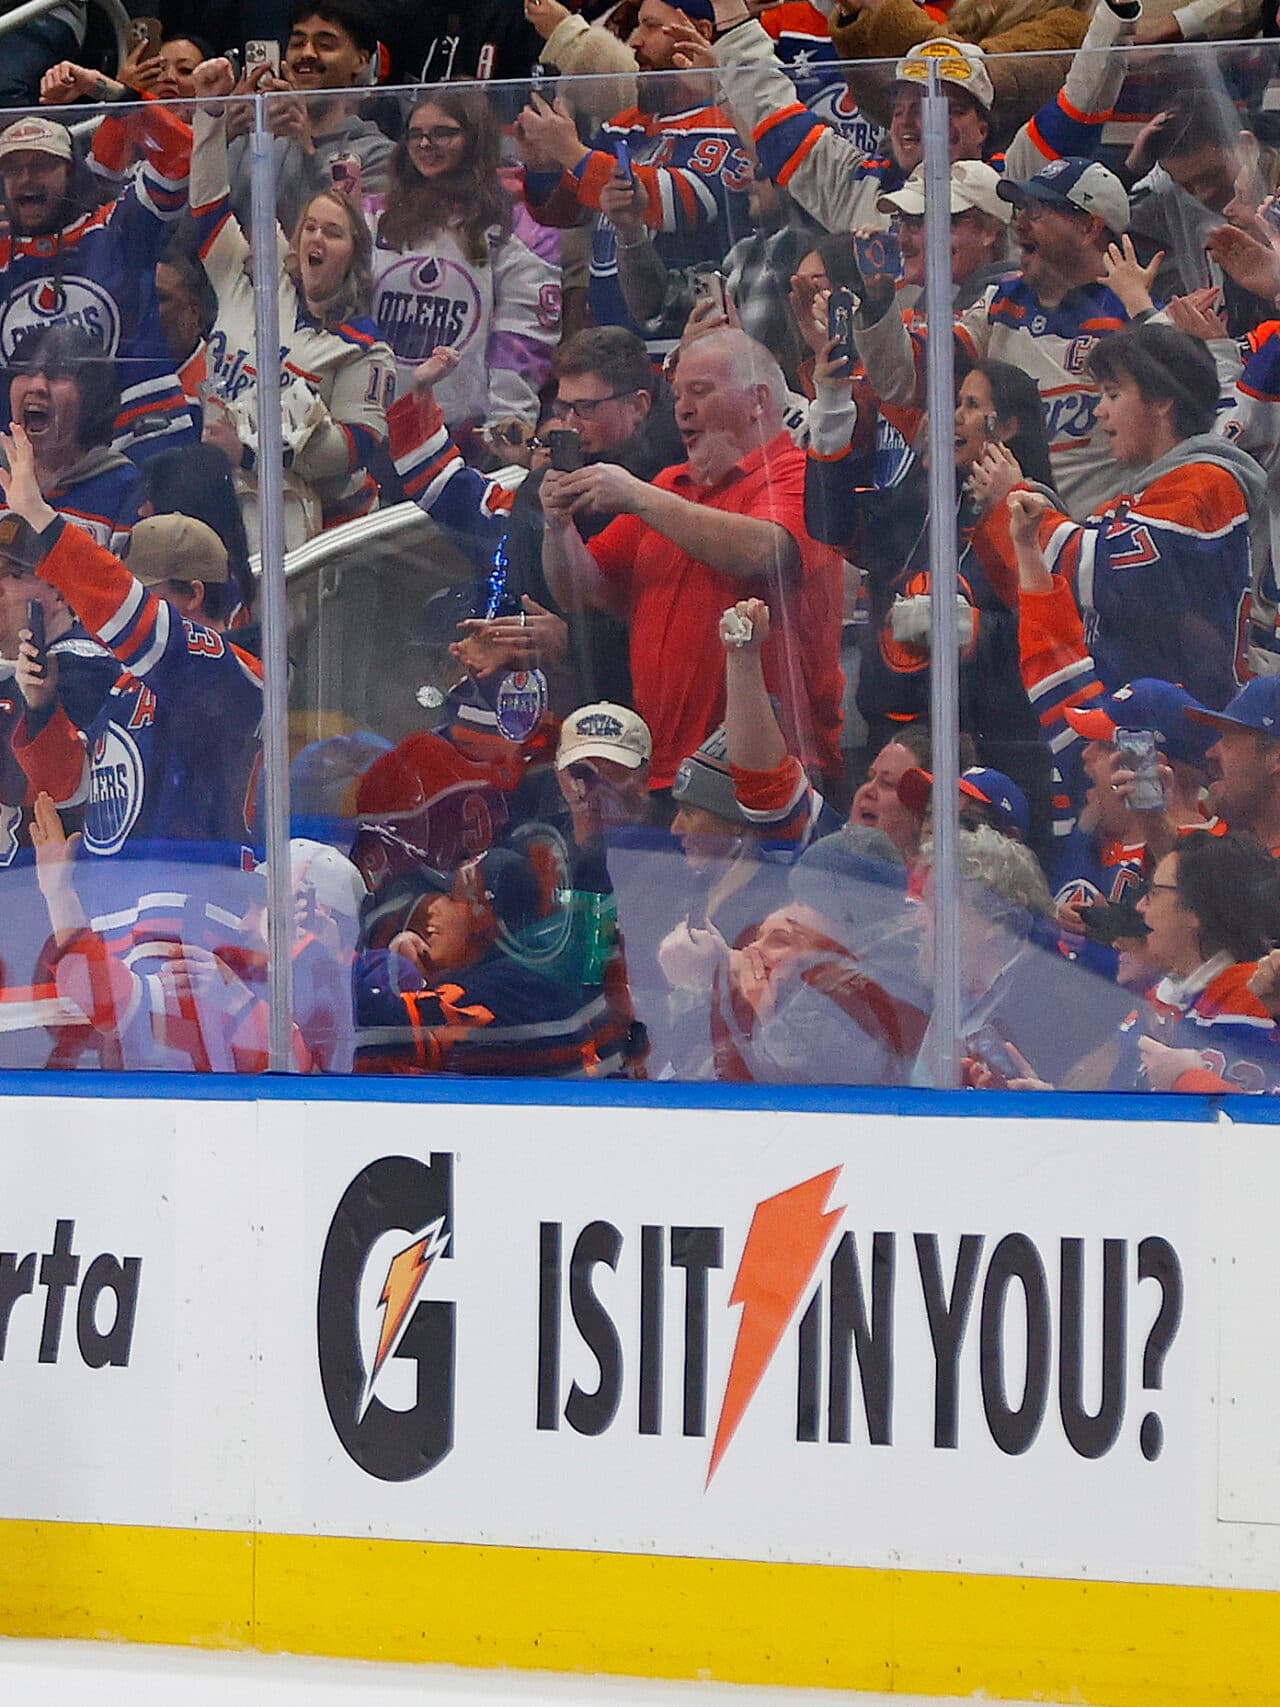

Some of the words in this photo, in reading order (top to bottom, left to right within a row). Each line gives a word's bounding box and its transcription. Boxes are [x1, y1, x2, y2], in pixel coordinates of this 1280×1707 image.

[378, 291, 469, 352] OILERS
[317, 1152, 456, 1482] G
[796, 1231, 896, 1446] IN
[913, 1233, 1185, 1463] YOU?
